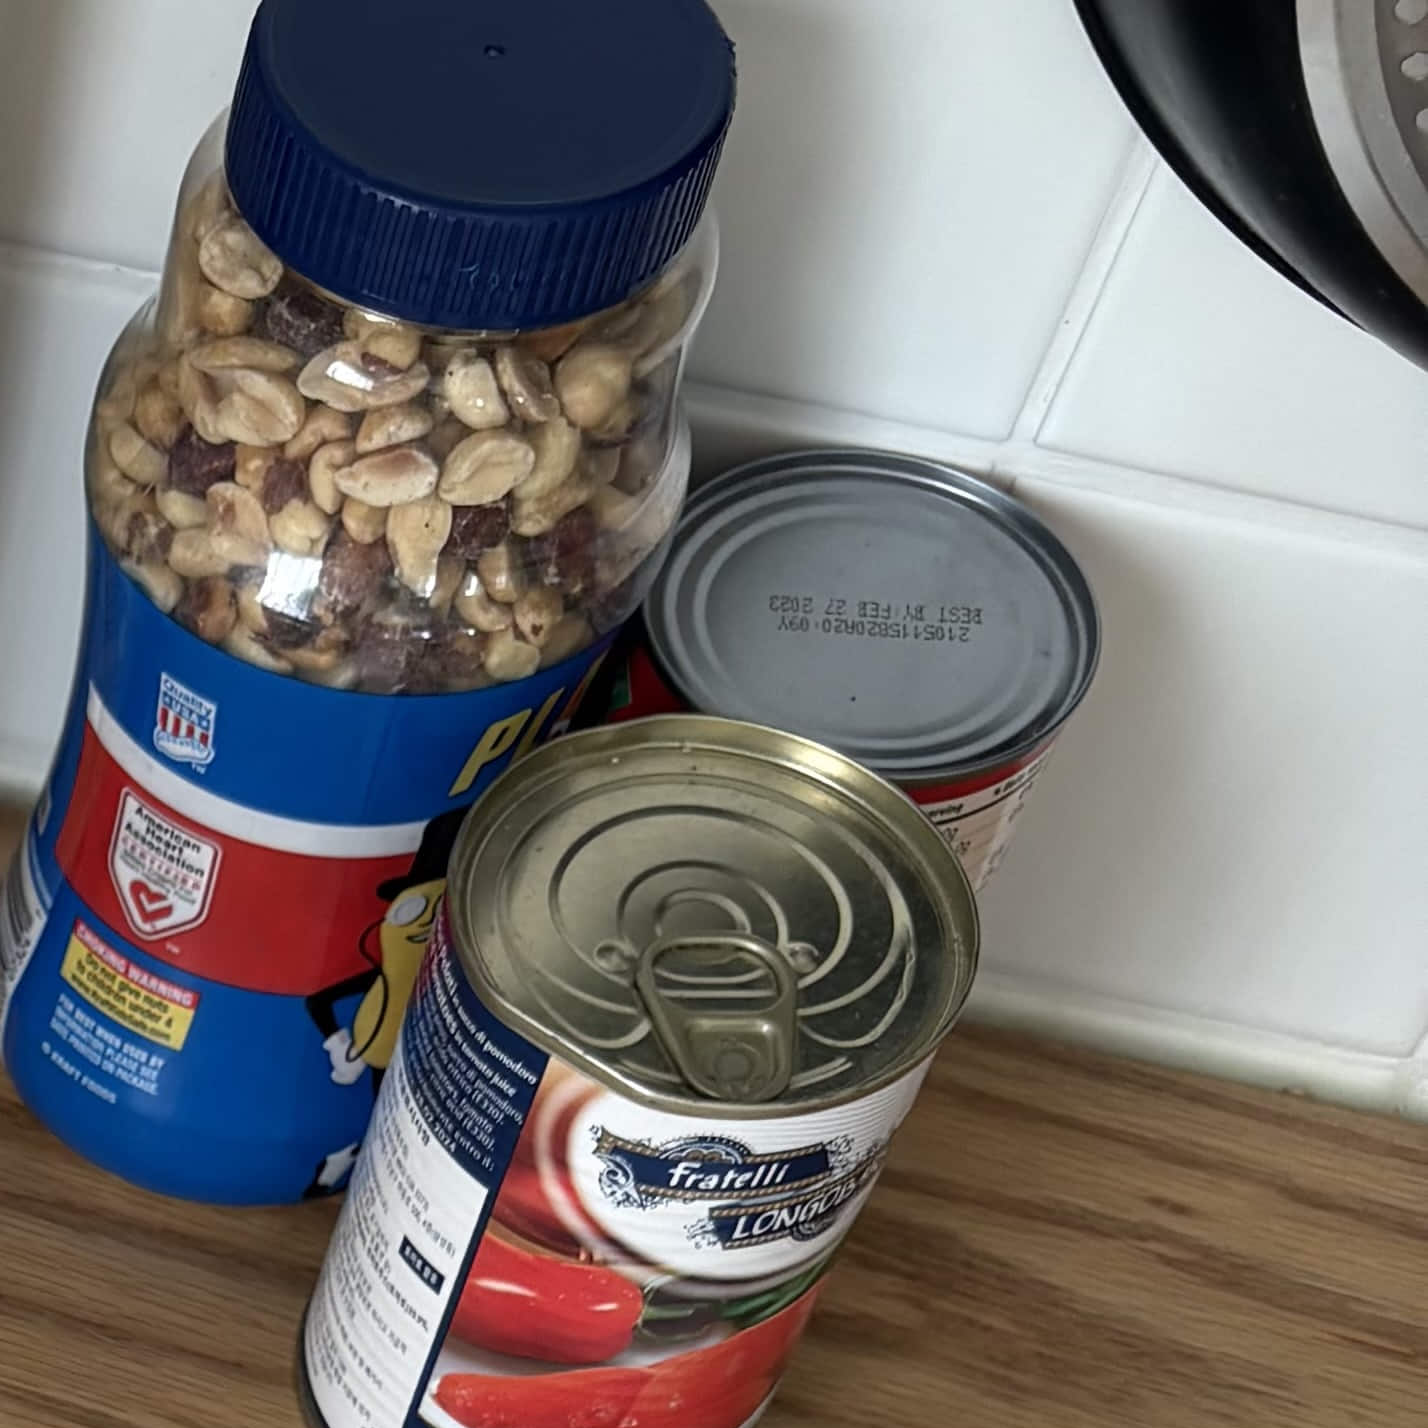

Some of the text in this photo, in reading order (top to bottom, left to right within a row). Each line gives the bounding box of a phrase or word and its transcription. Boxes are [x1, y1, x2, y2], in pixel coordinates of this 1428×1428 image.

[936, 606, 984, 626] BEST
[134, 804, 202, 854] American
[145, 827, 187, 857] Heart
[123, 823, 205, 878] Association
